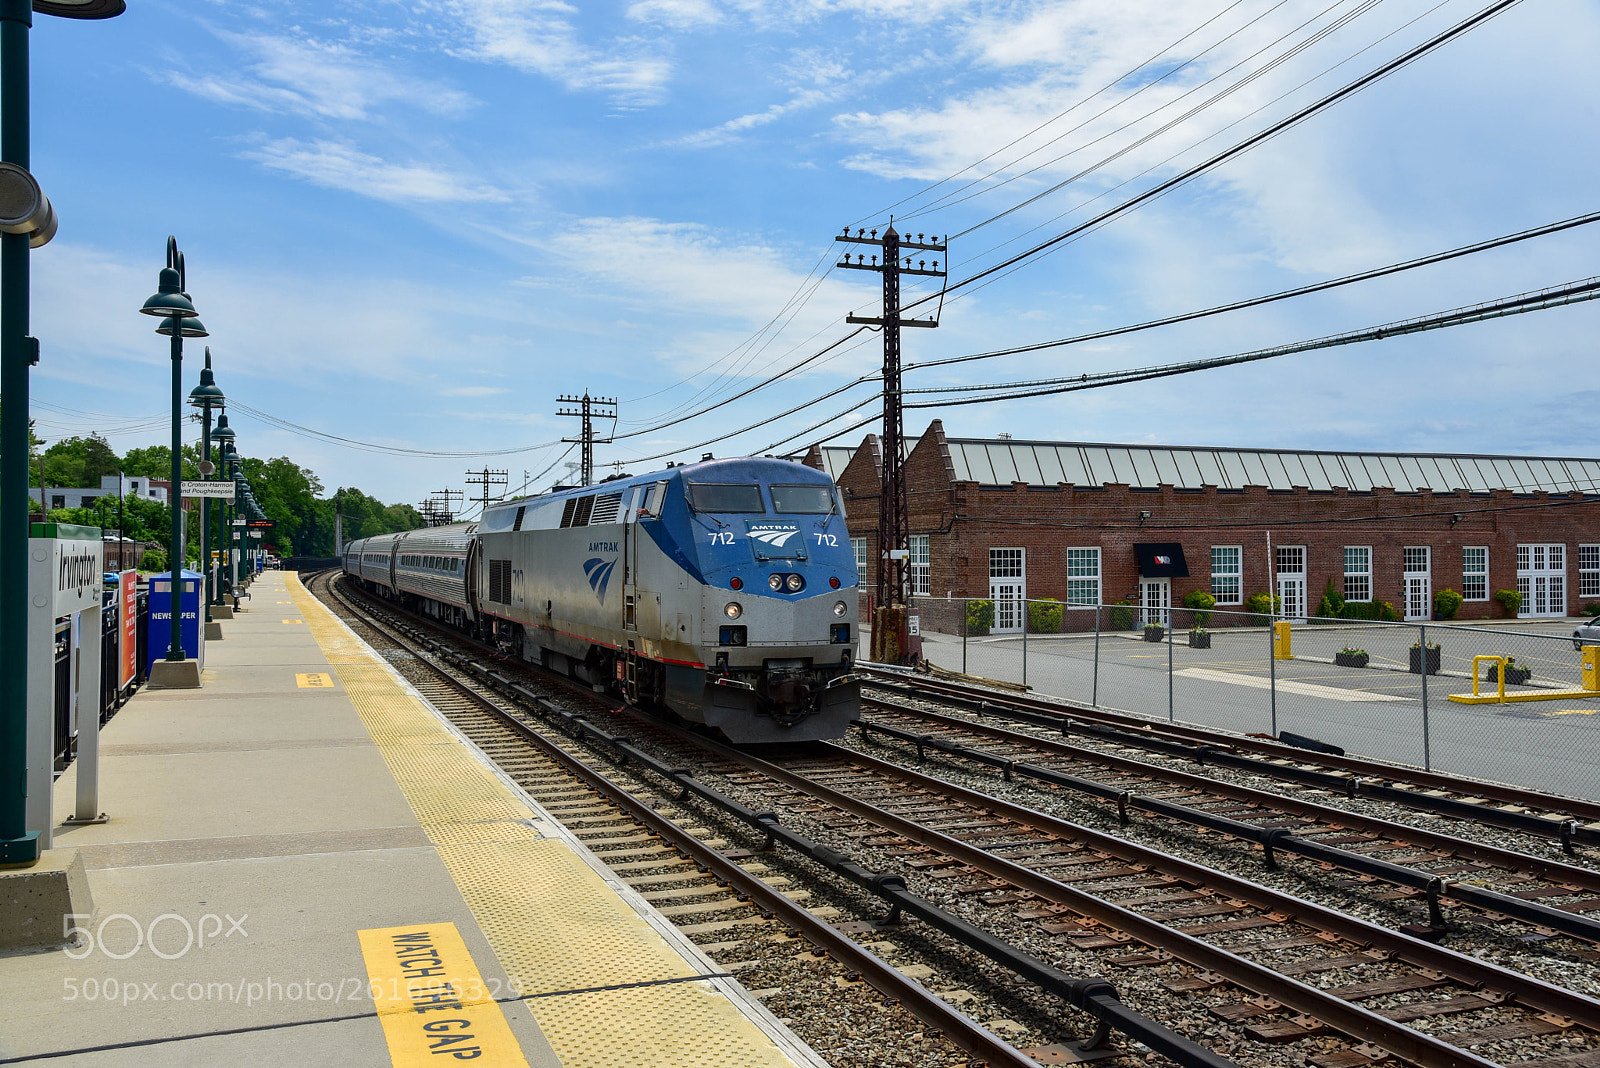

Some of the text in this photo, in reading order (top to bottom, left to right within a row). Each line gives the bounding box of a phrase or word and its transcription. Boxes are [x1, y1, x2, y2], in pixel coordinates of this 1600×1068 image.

[707, 532, 736, 546] 712
[813, 532, 839, 547] 712
[588, 542, 619, 552] AMTRAK
[58, 543, 96, 599] Irvington
[391, 931, 482, 1060] WATCH THE GAP
